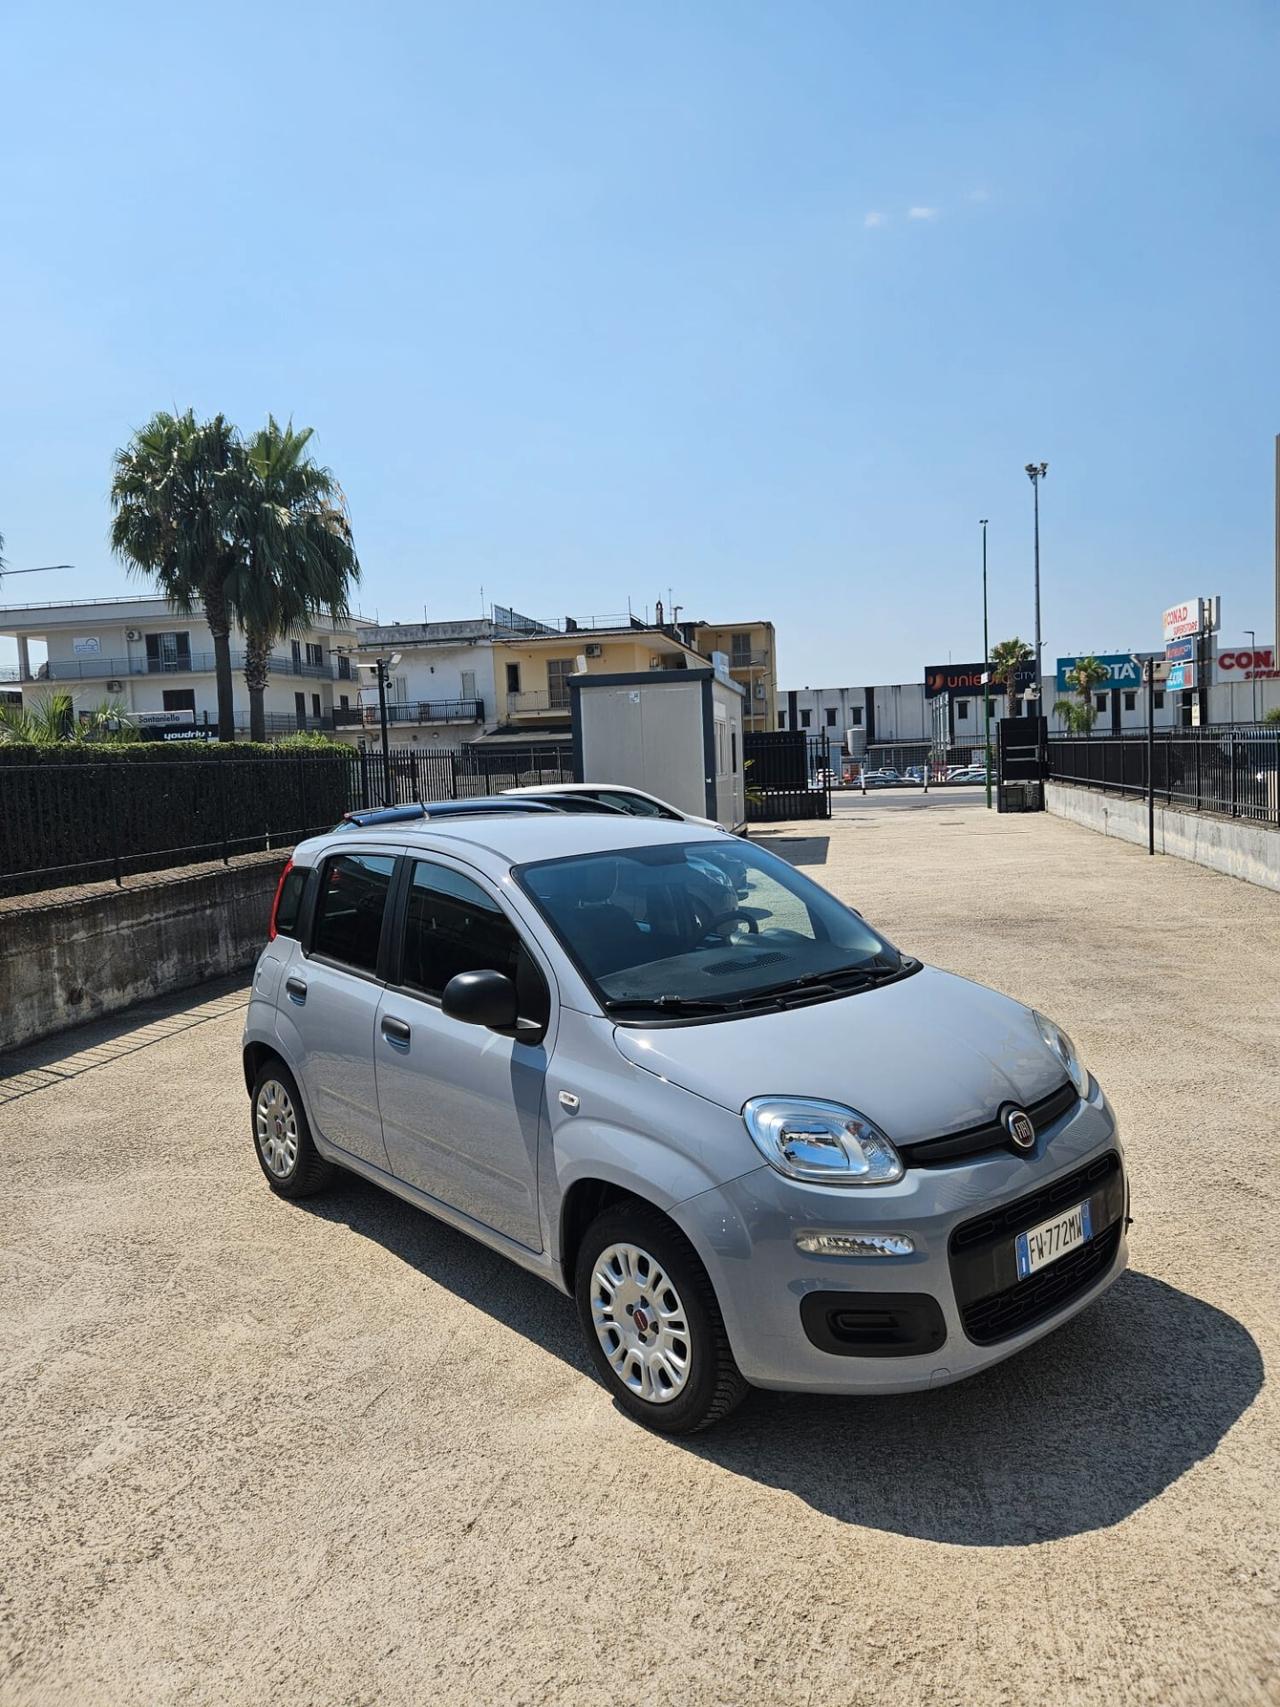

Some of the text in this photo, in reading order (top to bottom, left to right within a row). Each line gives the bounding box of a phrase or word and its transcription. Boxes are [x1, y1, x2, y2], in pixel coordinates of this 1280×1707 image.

[1167, 607, 1188, 625] CONAD
[1218, 651, 1275, 670] CON
[1014, 671, 1035, 681] CITY
[1015, 1120, 1030, 1139] FIAT
